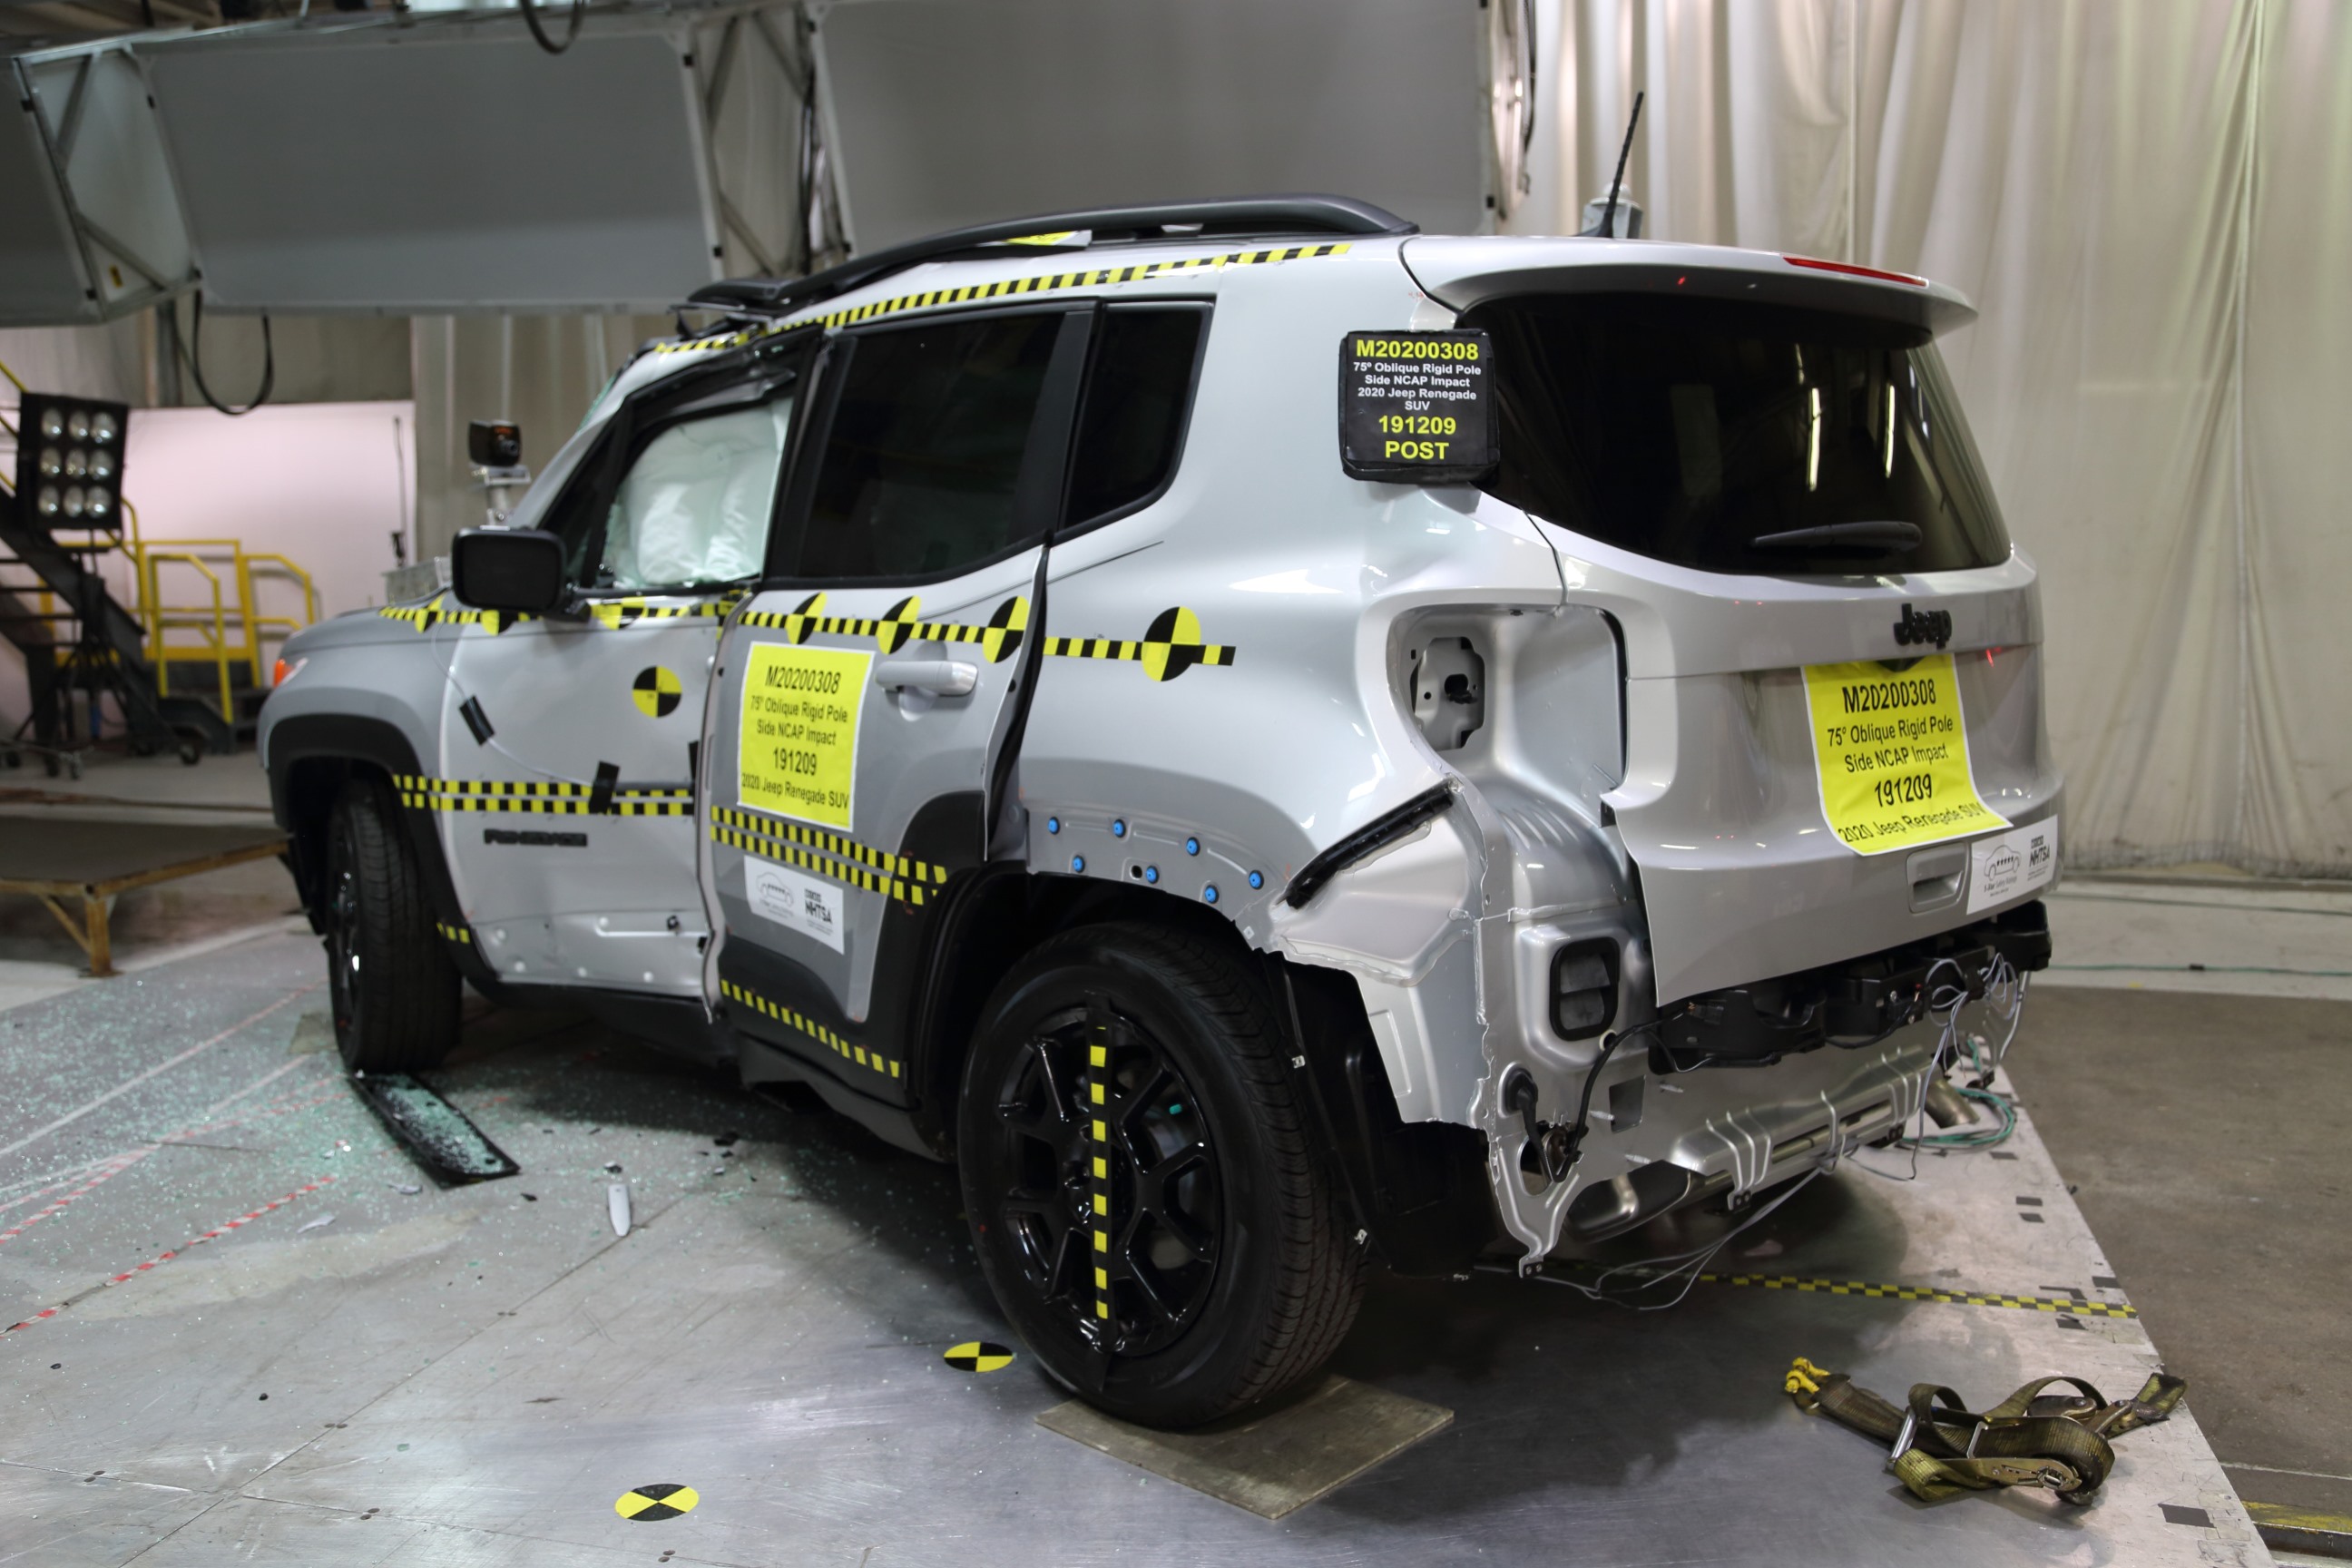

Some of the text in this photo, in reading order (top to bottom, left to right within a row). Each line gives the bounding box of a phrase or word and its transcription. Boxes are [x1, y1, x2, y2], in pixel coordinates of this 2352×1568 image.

[1356, 339, 1479, 360] M20200308
[1365, 375, 1470, 387] Side NCAP Impact
[1375, 363, 1419, 374] Oblique
[1422, 364, 1453, 375] Rigid
[1455, 364, 1482, 375] Pole
[1357, 387, 1476, 400] 2020 Jeep Renegade
[1405, 401, 1430, 410] SUV
[1378, 416, 1456, 435] 191209
[1385, 441, 1449, 459] POST
[1893, 603, 1953, 651] Jeep
[765, 666, 841, 694] M20200308
[765, 697, 799, 719] Oblique
[801, 701, 825, 722] Rigid
[827, 705, 848, 722] Pole
[1842, 679, 1937, 714] M20200308
[757, 719, 837, 747] Side NCAP Impact
[1849, 724, 1896, 745] Oblique
[1898, 717, 1927, 740] Rigid
[1929, 714, 1954, 733] Pole
[773, 747, 818, 776] 191209
[1844, 743, 1950, 773] Side NCAP Impact
[740, 773, 849, 809] 2020 Jeep Renegade SUV
[1874, 773, 1933, 808] 191209
[1838, 801, 1988, 843] 2020 Jeep Renegade SUV
